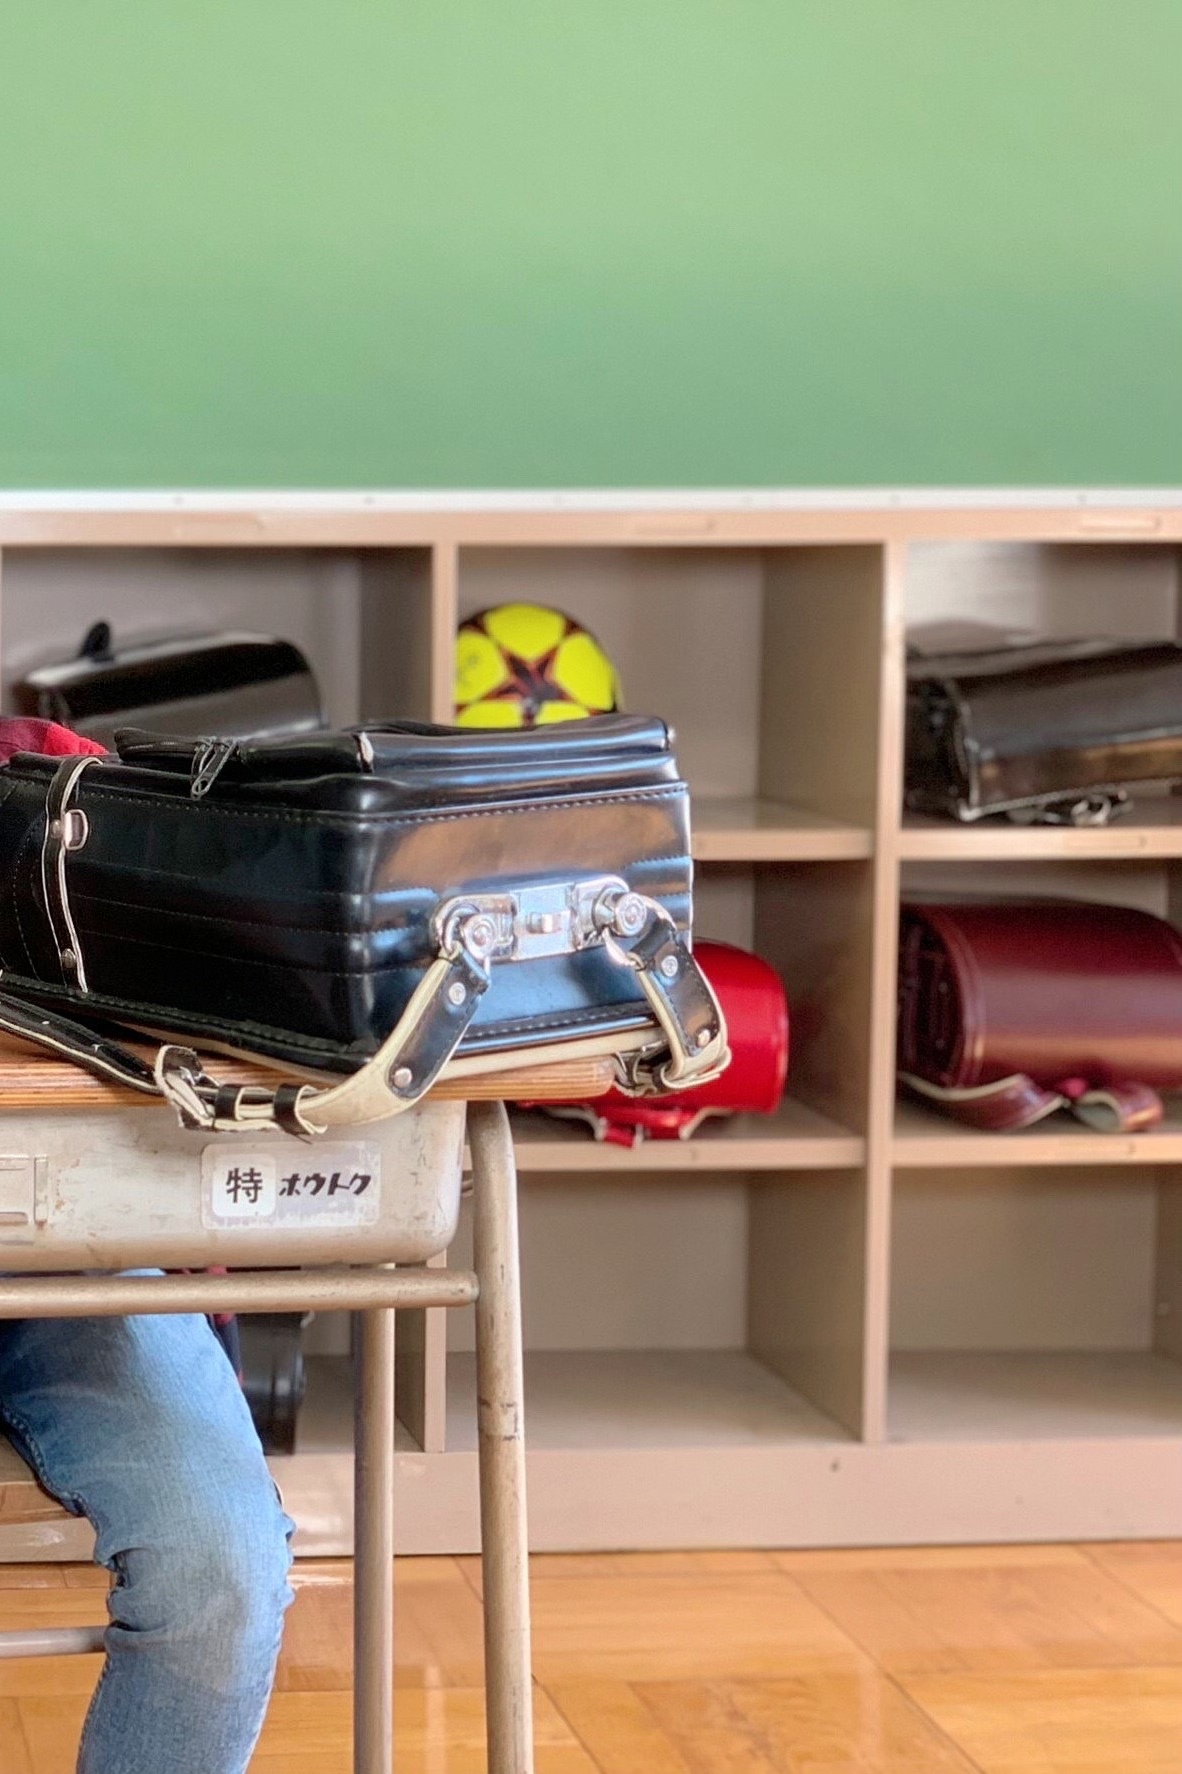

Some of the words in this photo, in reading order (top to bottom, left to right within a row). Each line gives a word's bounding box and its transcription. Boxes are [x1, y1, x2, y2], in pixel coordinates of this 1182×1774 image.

[225, 1167, 264, 1204] 特
[279, 1171, 372, 1197] ホウトク
